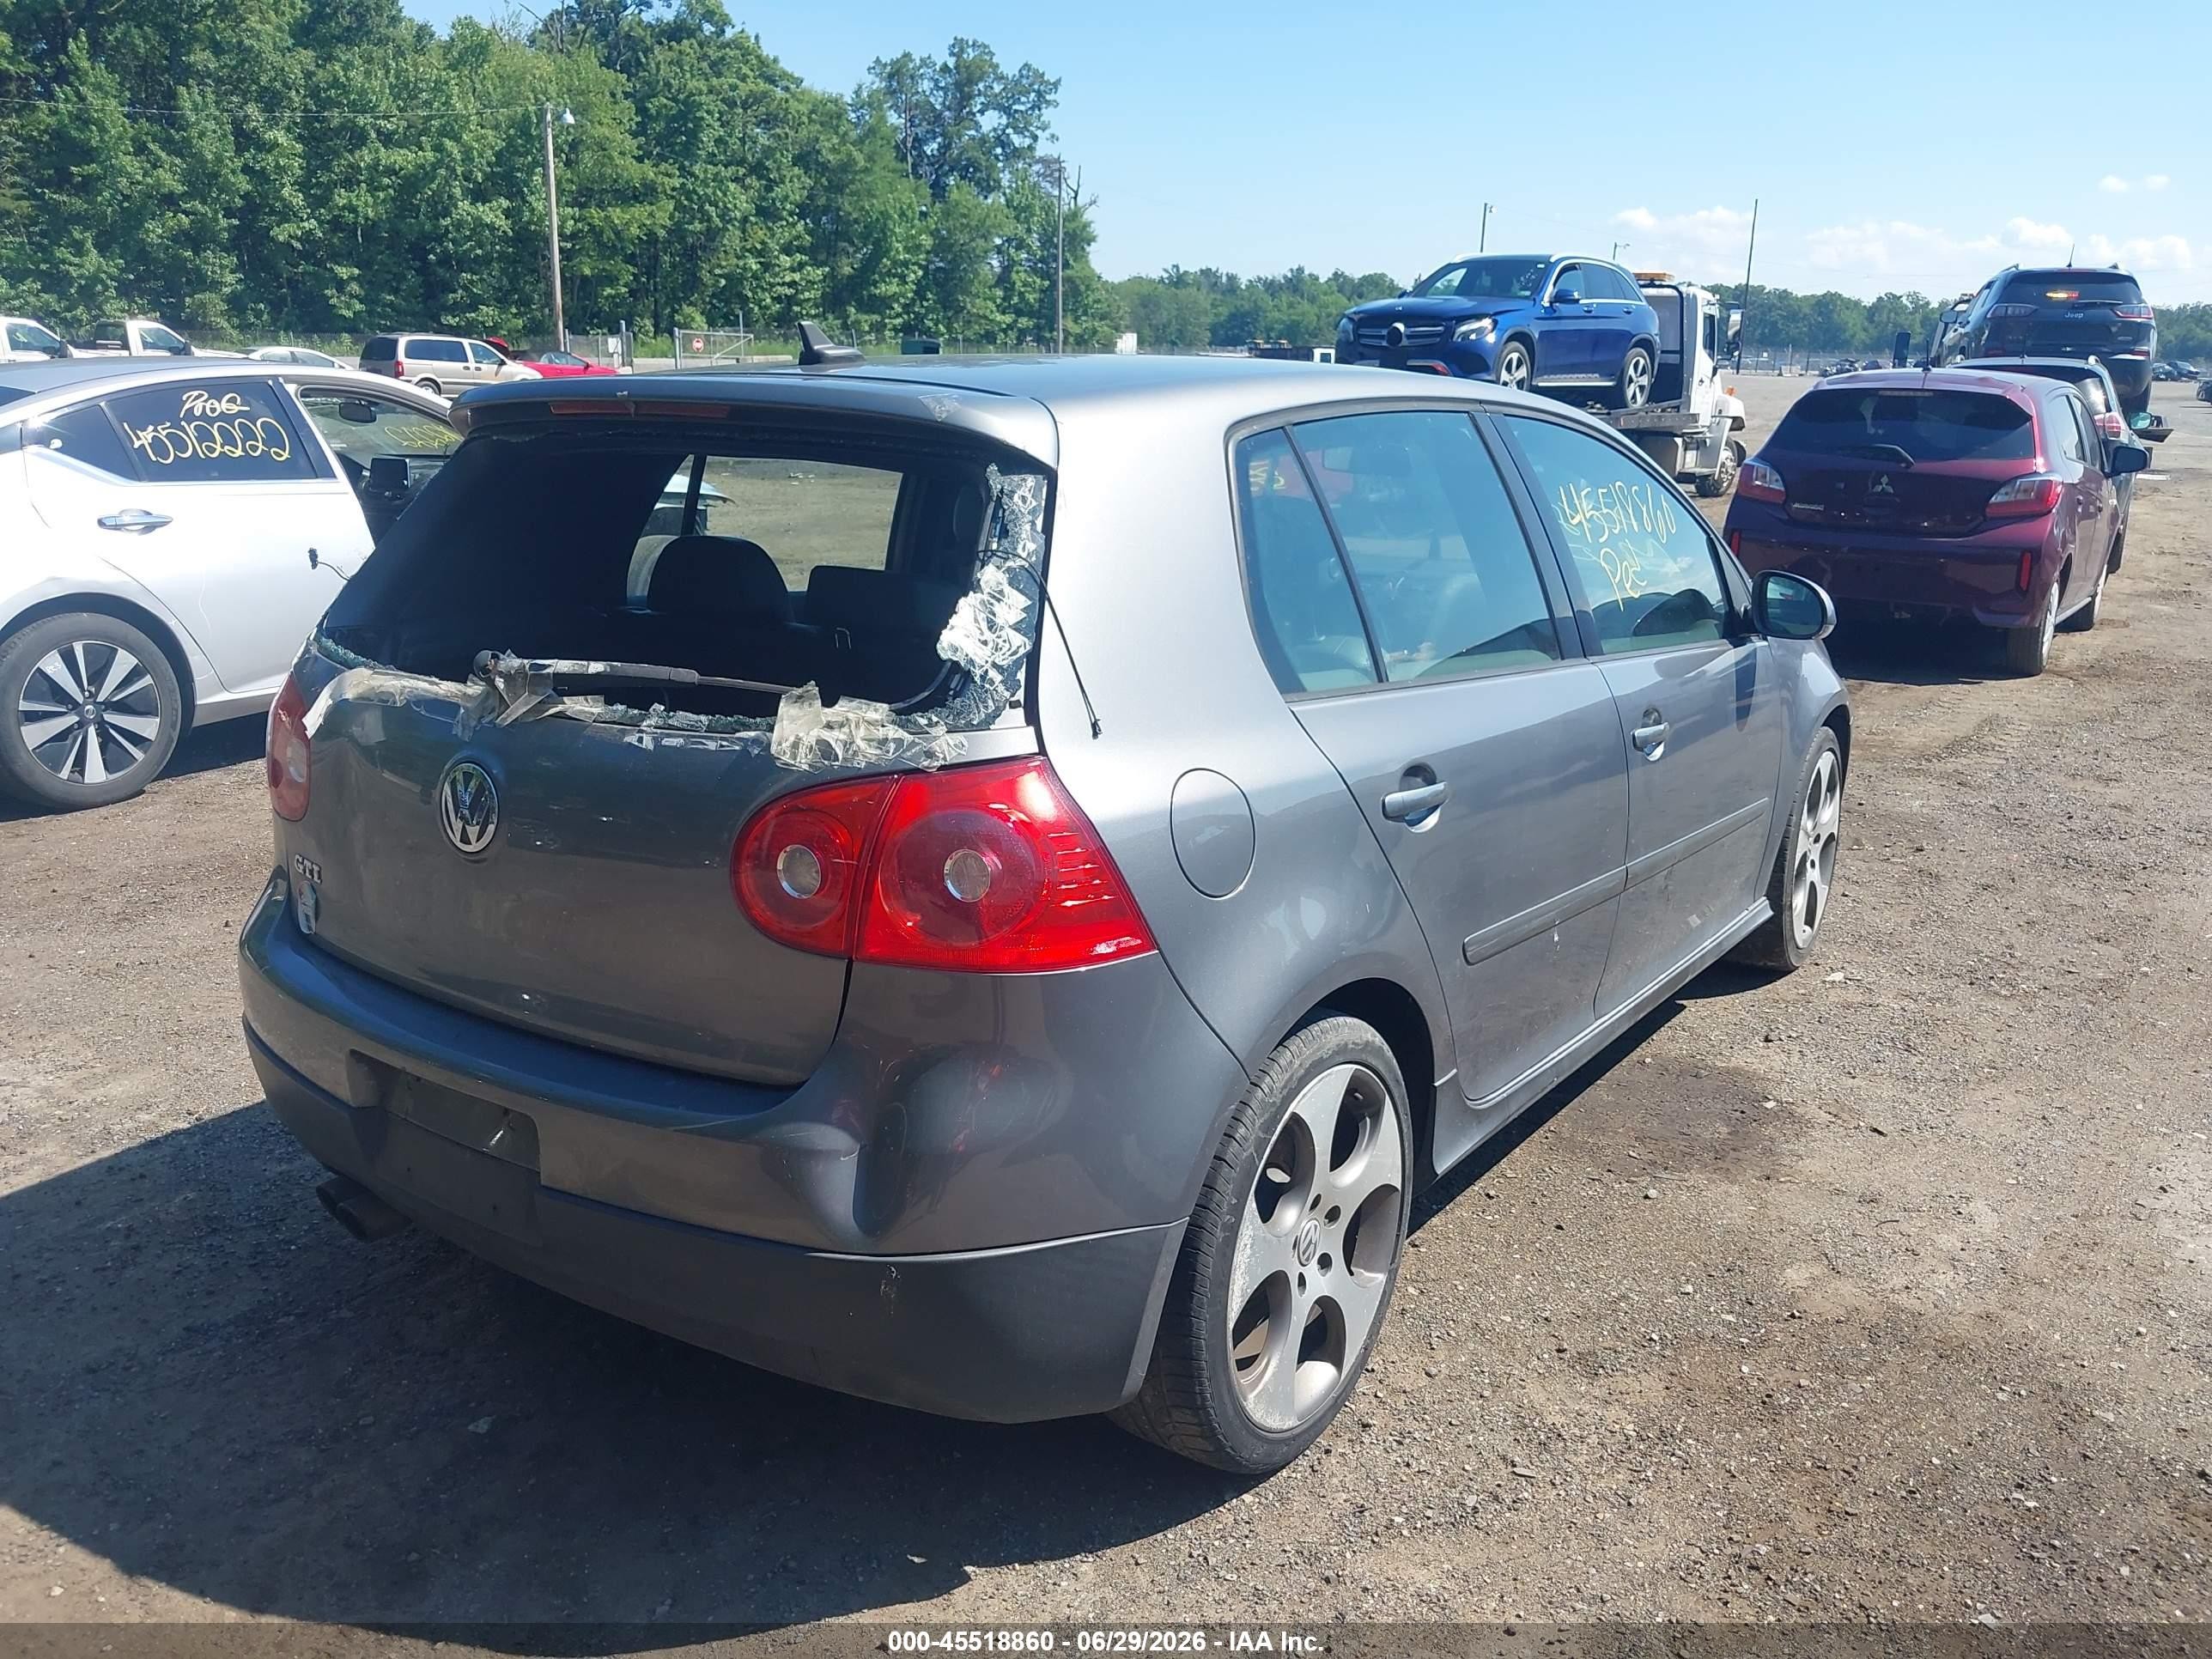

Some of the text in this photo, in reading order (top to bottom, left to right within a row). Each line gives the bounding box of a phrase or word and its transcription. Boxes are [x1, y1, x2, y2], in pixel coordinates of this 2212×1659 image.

[123, 417, 291, 465] 45512222
[1559, 481, 1677, 544] 45518860
[295, 854, 322, 884] GTI
